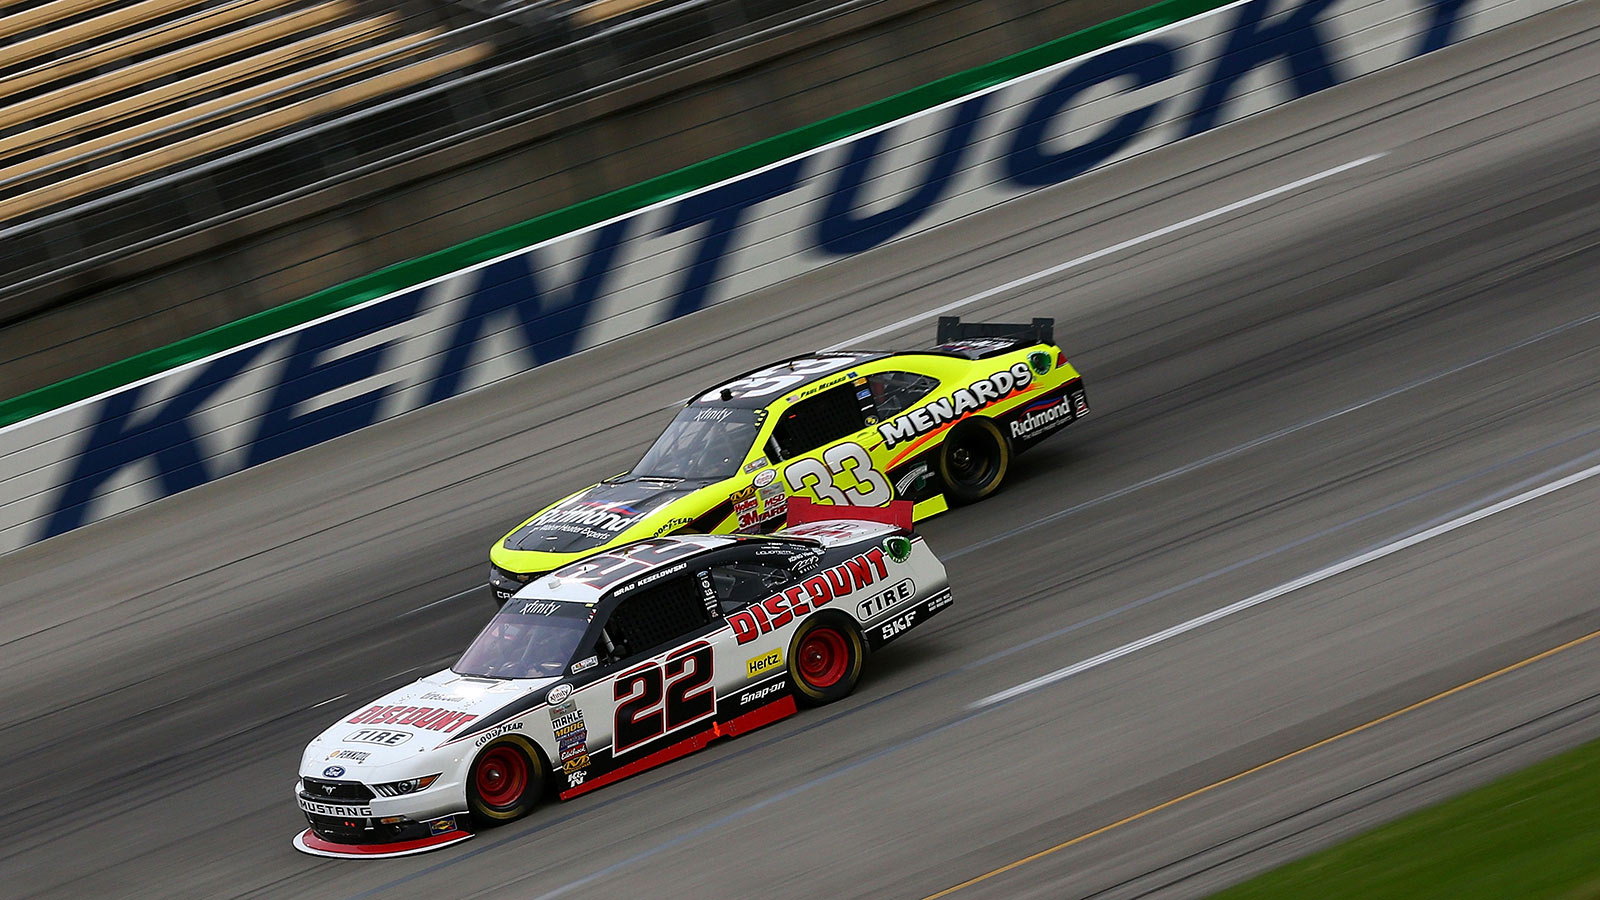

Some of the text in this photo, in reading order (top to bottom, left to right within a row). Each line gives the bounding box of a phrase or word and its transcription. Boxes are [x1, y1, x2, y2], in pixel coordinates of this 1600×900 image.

[878, 362, 1033, 448] MENARDS
[1010, 395, 1071, 438] Richmond
[784, 442, 892, 507] 33
[765, 493, 785, 508] MSD
[738, 510, 759, 529] 3M
[613, 583, 635, 597] BRAD
[724, 546, 892, 646] DISCOUNT
[860, 582, 910, 616] TIRE
[519, 600, 562, 617] xfinity
[882, 611, 916, 640] SKF
[612, 640, 717, 758] 22
[740, 680, 786, 705] Snap-on
[346, 705, 480, 733] DISCOUNT
[552, 710, 584, 729] MAHLE
[555, 720, 584, 737] MOOG
[350, 730, 406, 745] TIRE
[300, 800, 373, 817] MUSTANG
